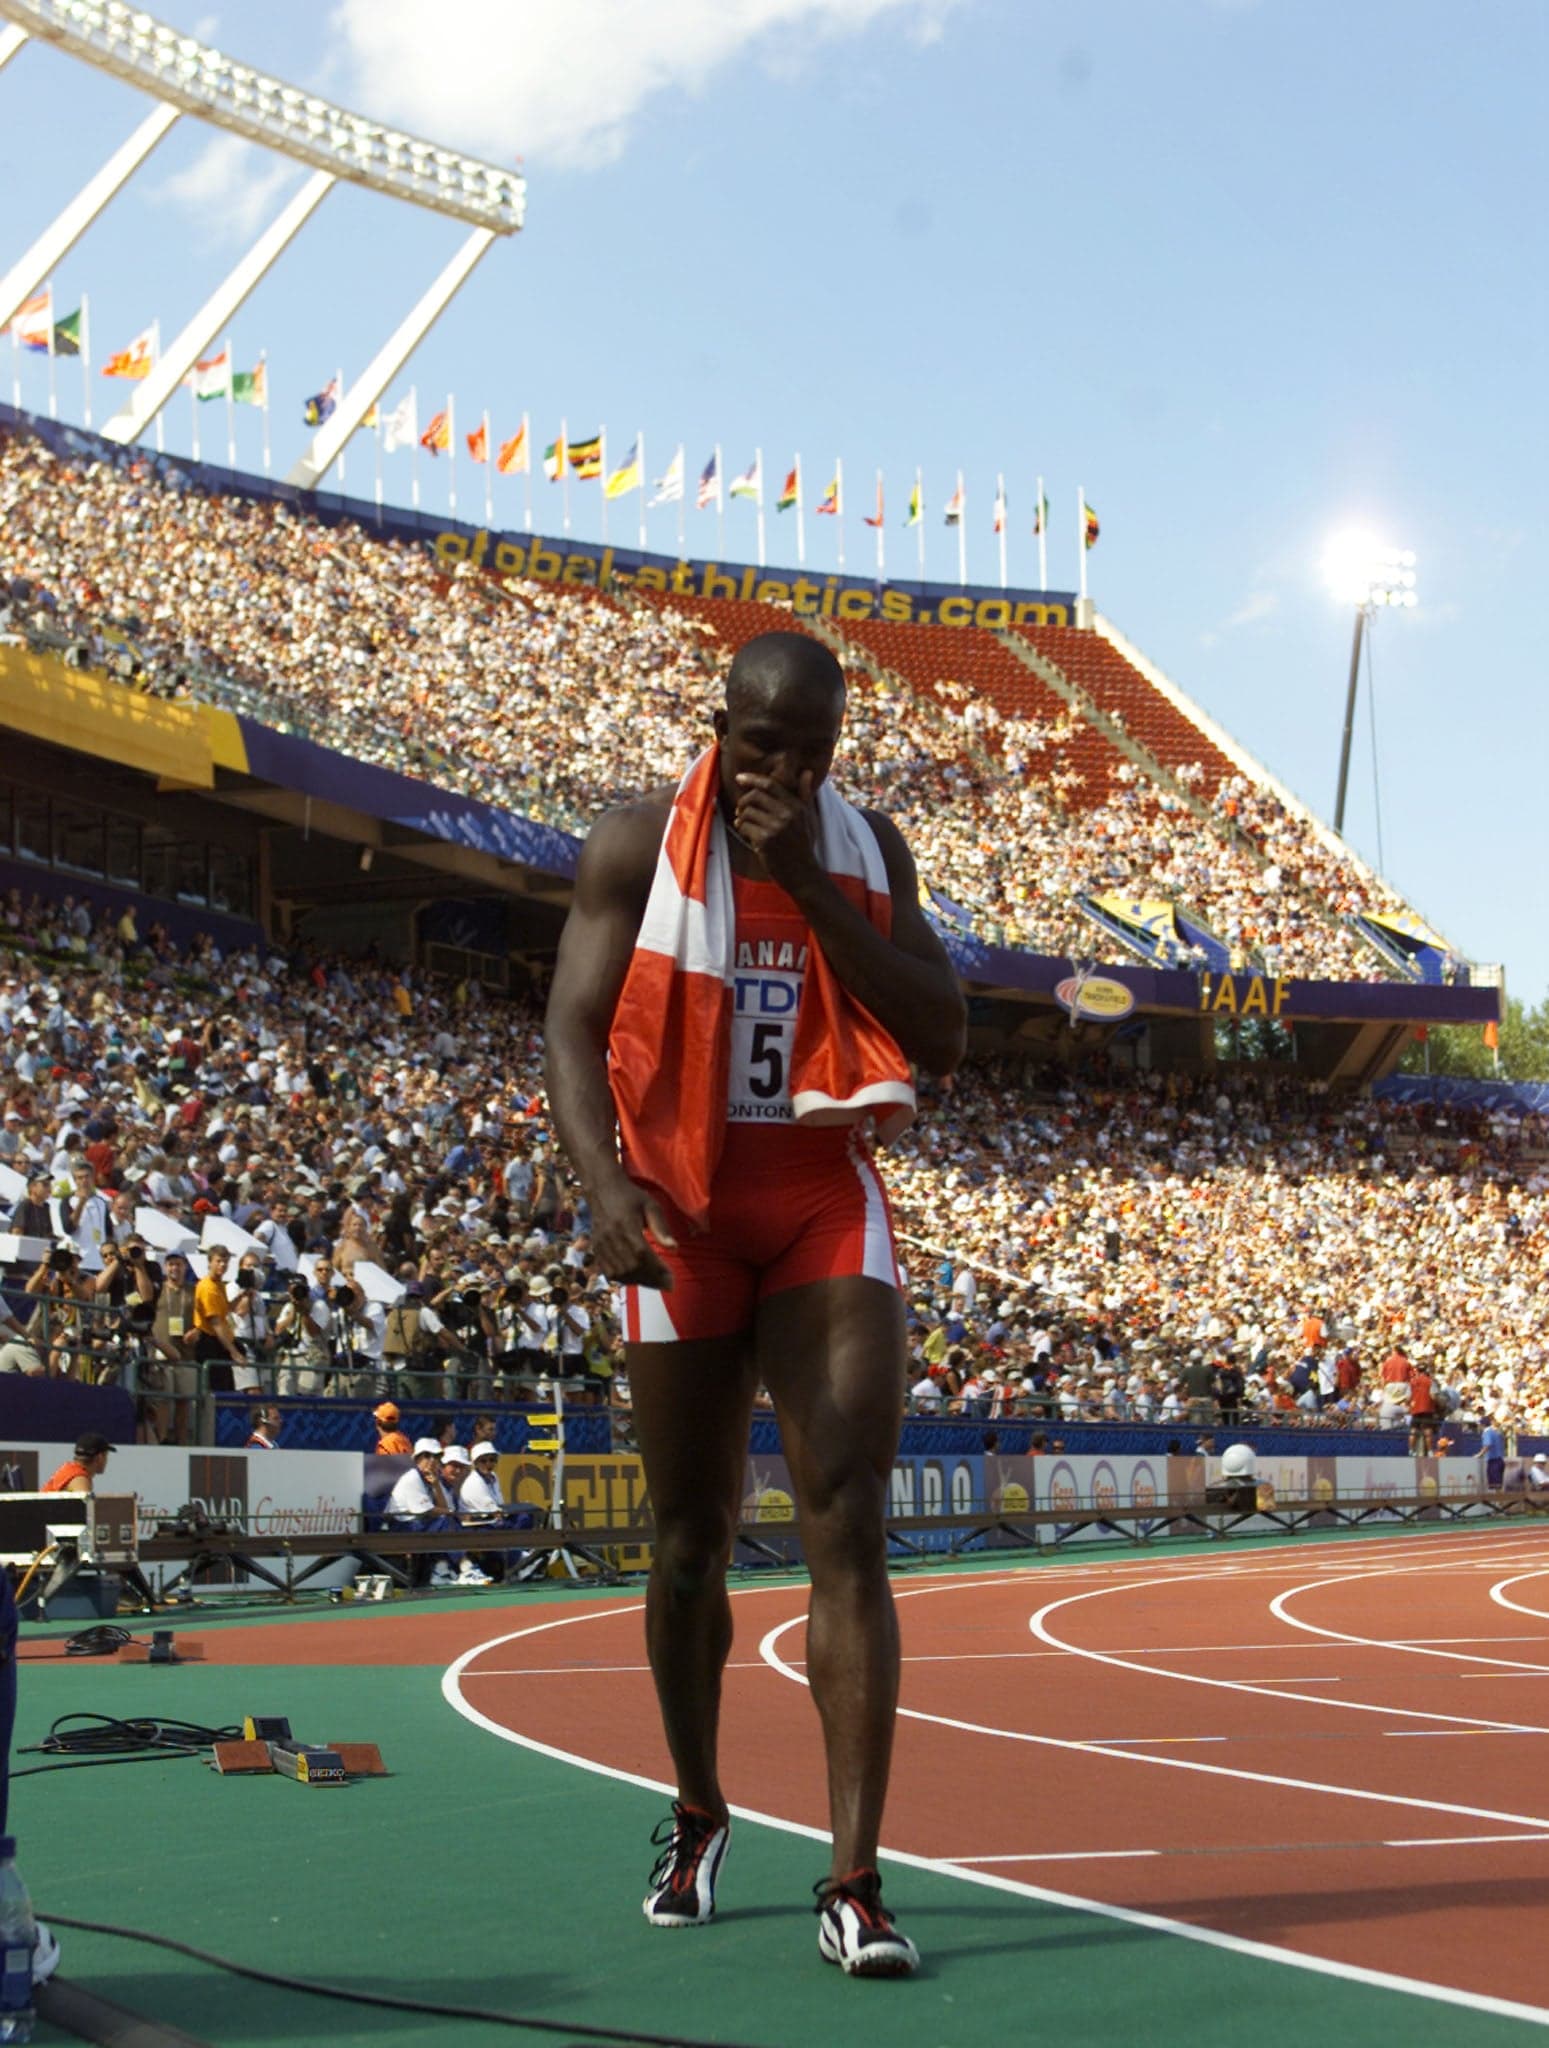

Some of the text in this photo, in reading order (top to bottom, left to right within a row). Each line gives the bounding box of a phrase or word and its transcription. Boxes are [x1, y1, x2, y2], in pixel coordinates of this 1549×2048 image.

[1201, 972, 1291, 1016] IAAF
[749, 1023, 783, 1098] 5
[255, 1496, 356, 1535] Consulting
[309, 1768, 345, 1777] SEIKO
